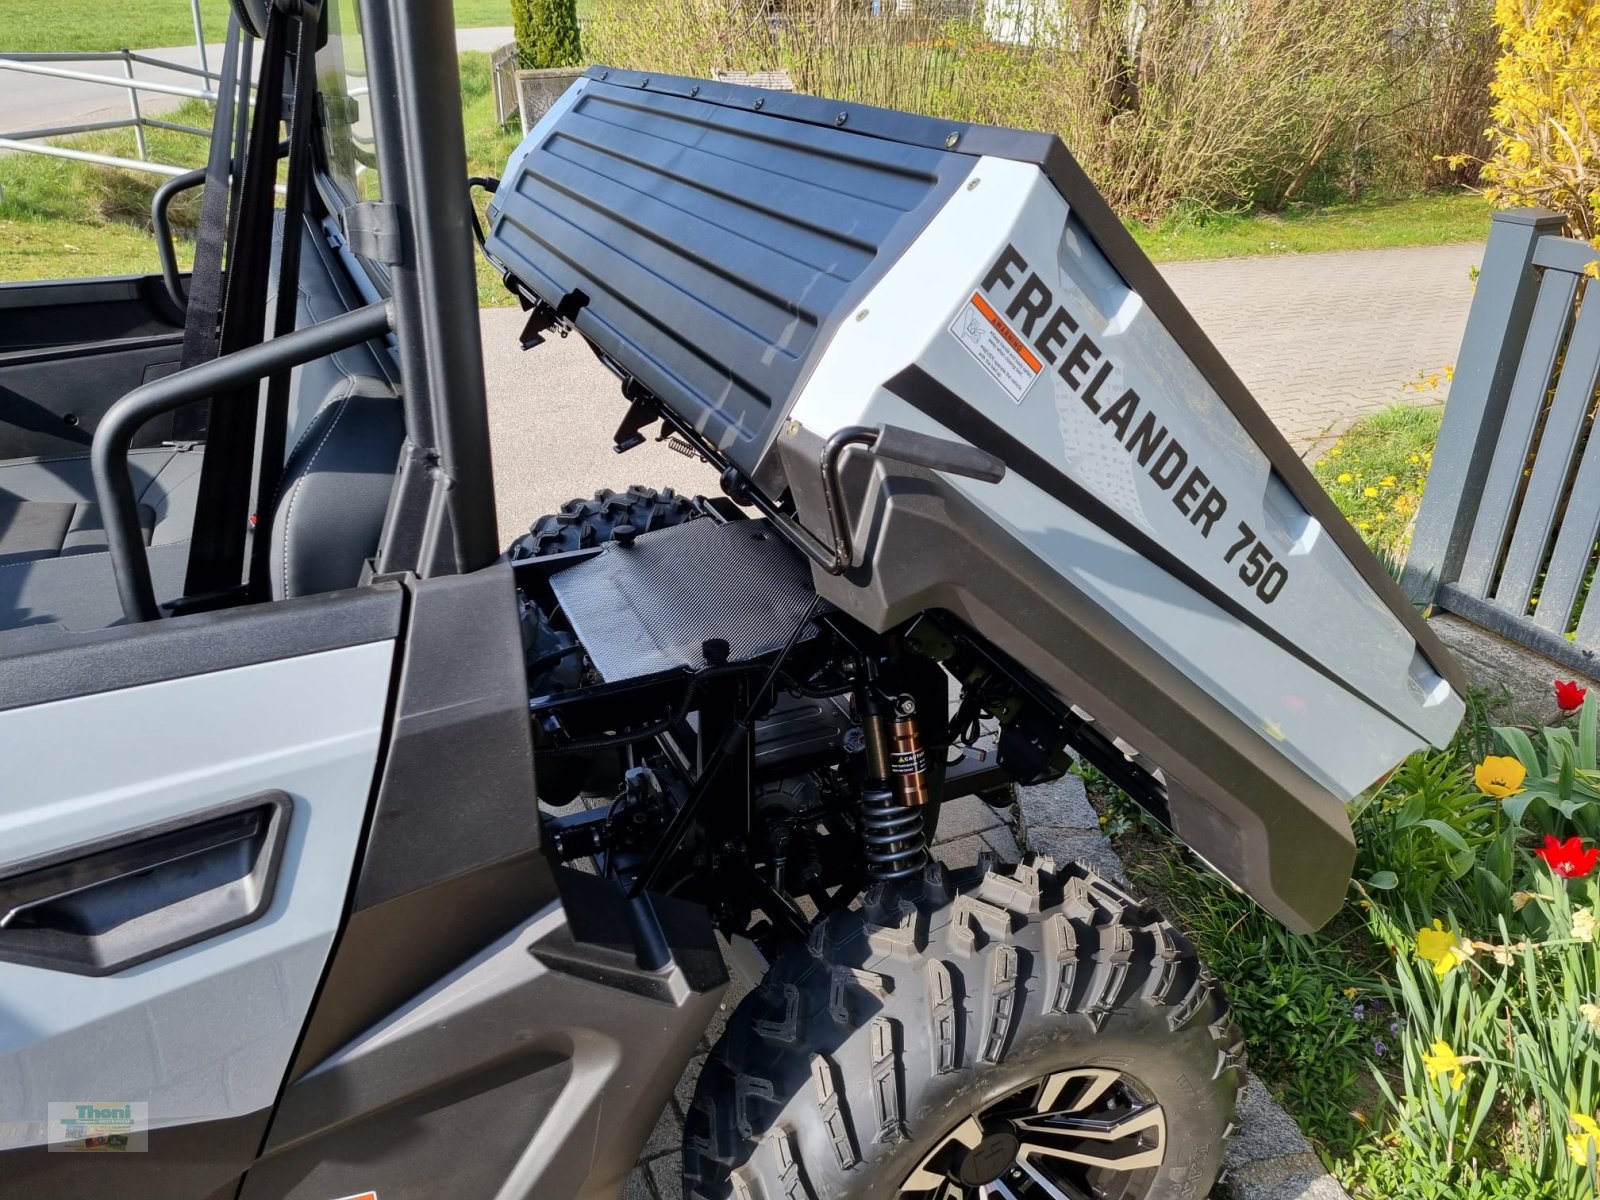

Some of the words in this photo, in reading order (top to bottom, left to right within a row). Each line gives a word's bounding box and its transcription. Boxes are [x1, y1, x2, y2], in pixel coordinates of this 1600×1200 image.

[981, 243, 1228, 538] FREELANDER
[1223, 520, 1289, 604] 750
[996, 321, 1023, 352] WARNING
